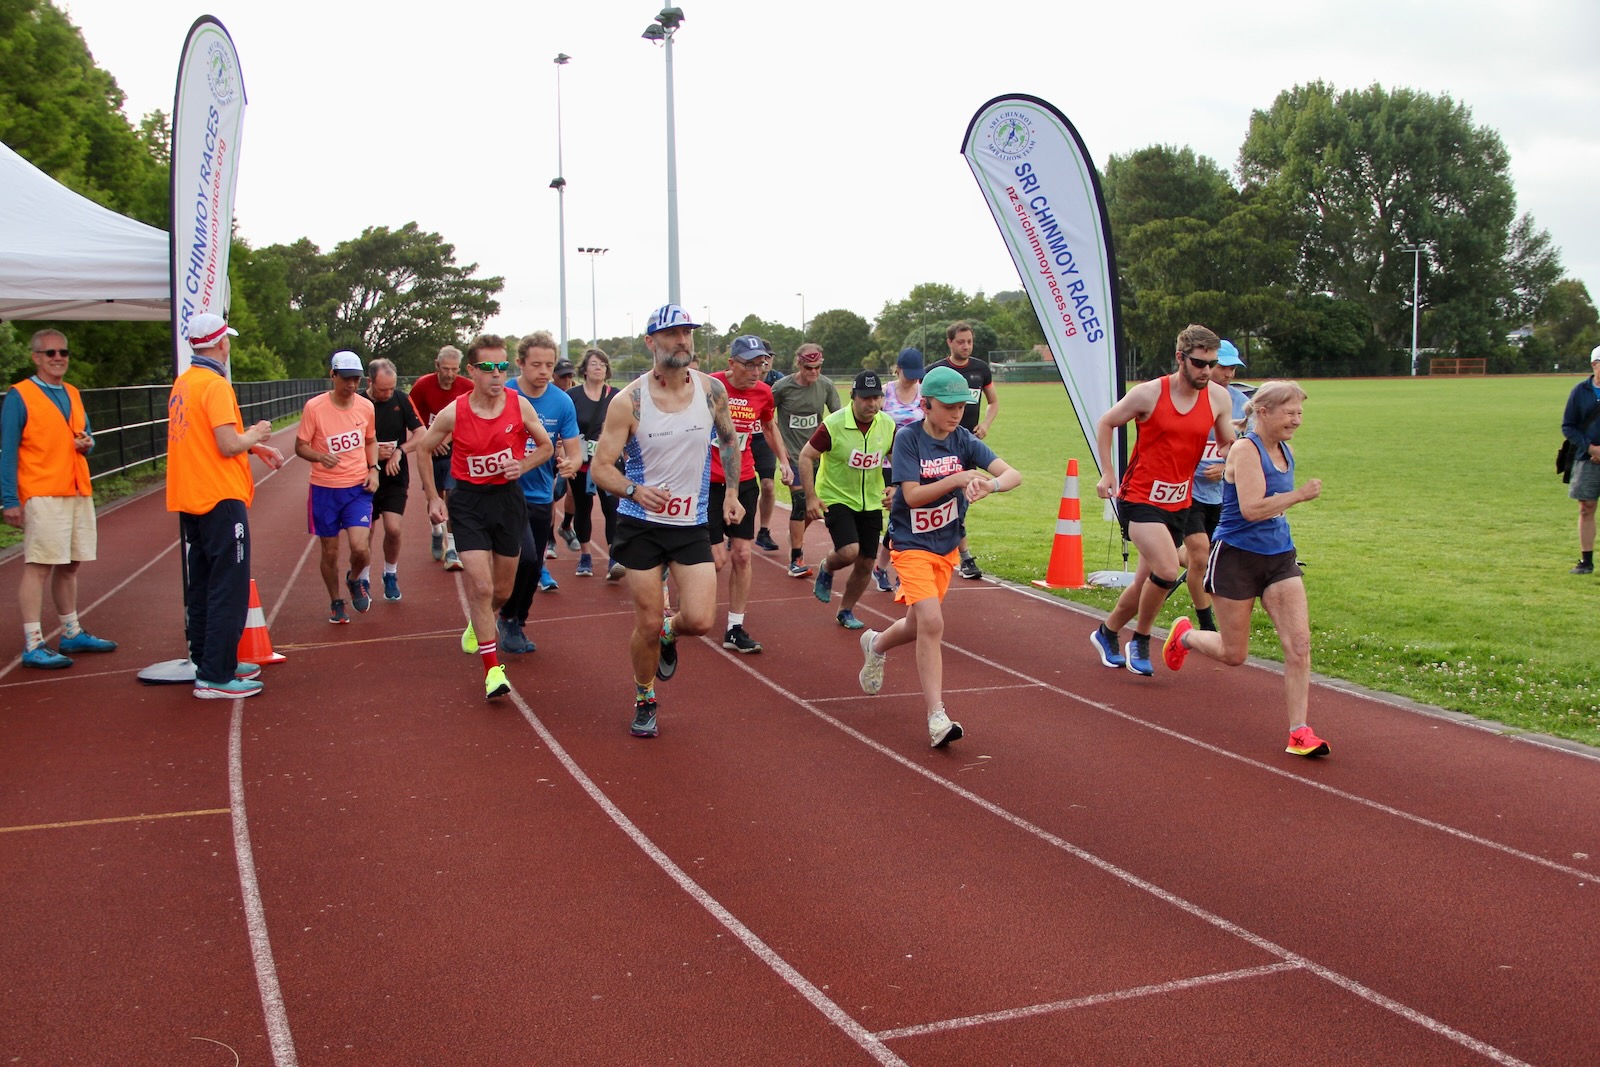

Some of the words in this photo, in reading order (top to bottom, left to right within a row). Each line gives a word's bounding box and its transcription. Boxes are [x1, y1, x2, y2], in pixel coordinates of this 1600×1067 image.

[990, 118, 1000, 130] SRI
[1000, 112, 1032, 126] CHINMOY
[200, 105, 220, 186] RACES
[988, 143, 1022, 161] MARATHON
[1023, 140, 1036, 157] TEAM
[186, 183, 208, 295] CHINMOY
[1006, 186, 1077, 337] nz.srichinmoyraces.org
[1015, 163, 1041, 195] SRI
[1030, 196, 1079, 276] CHINMOY
[1066, 279, 1104, 343] RACES
[181, 297, 194, 341] SRI
[728, 397, 748, 406] 2020
[791, 415, 816, 428] 200
[331, 432, 360, 452] 563
[851, 452, 880, 468] 564
[920, 455, 958, 467] UNDER
[1154, 483, 1186, 501] 579
[915, 500, 954, 531] 567
